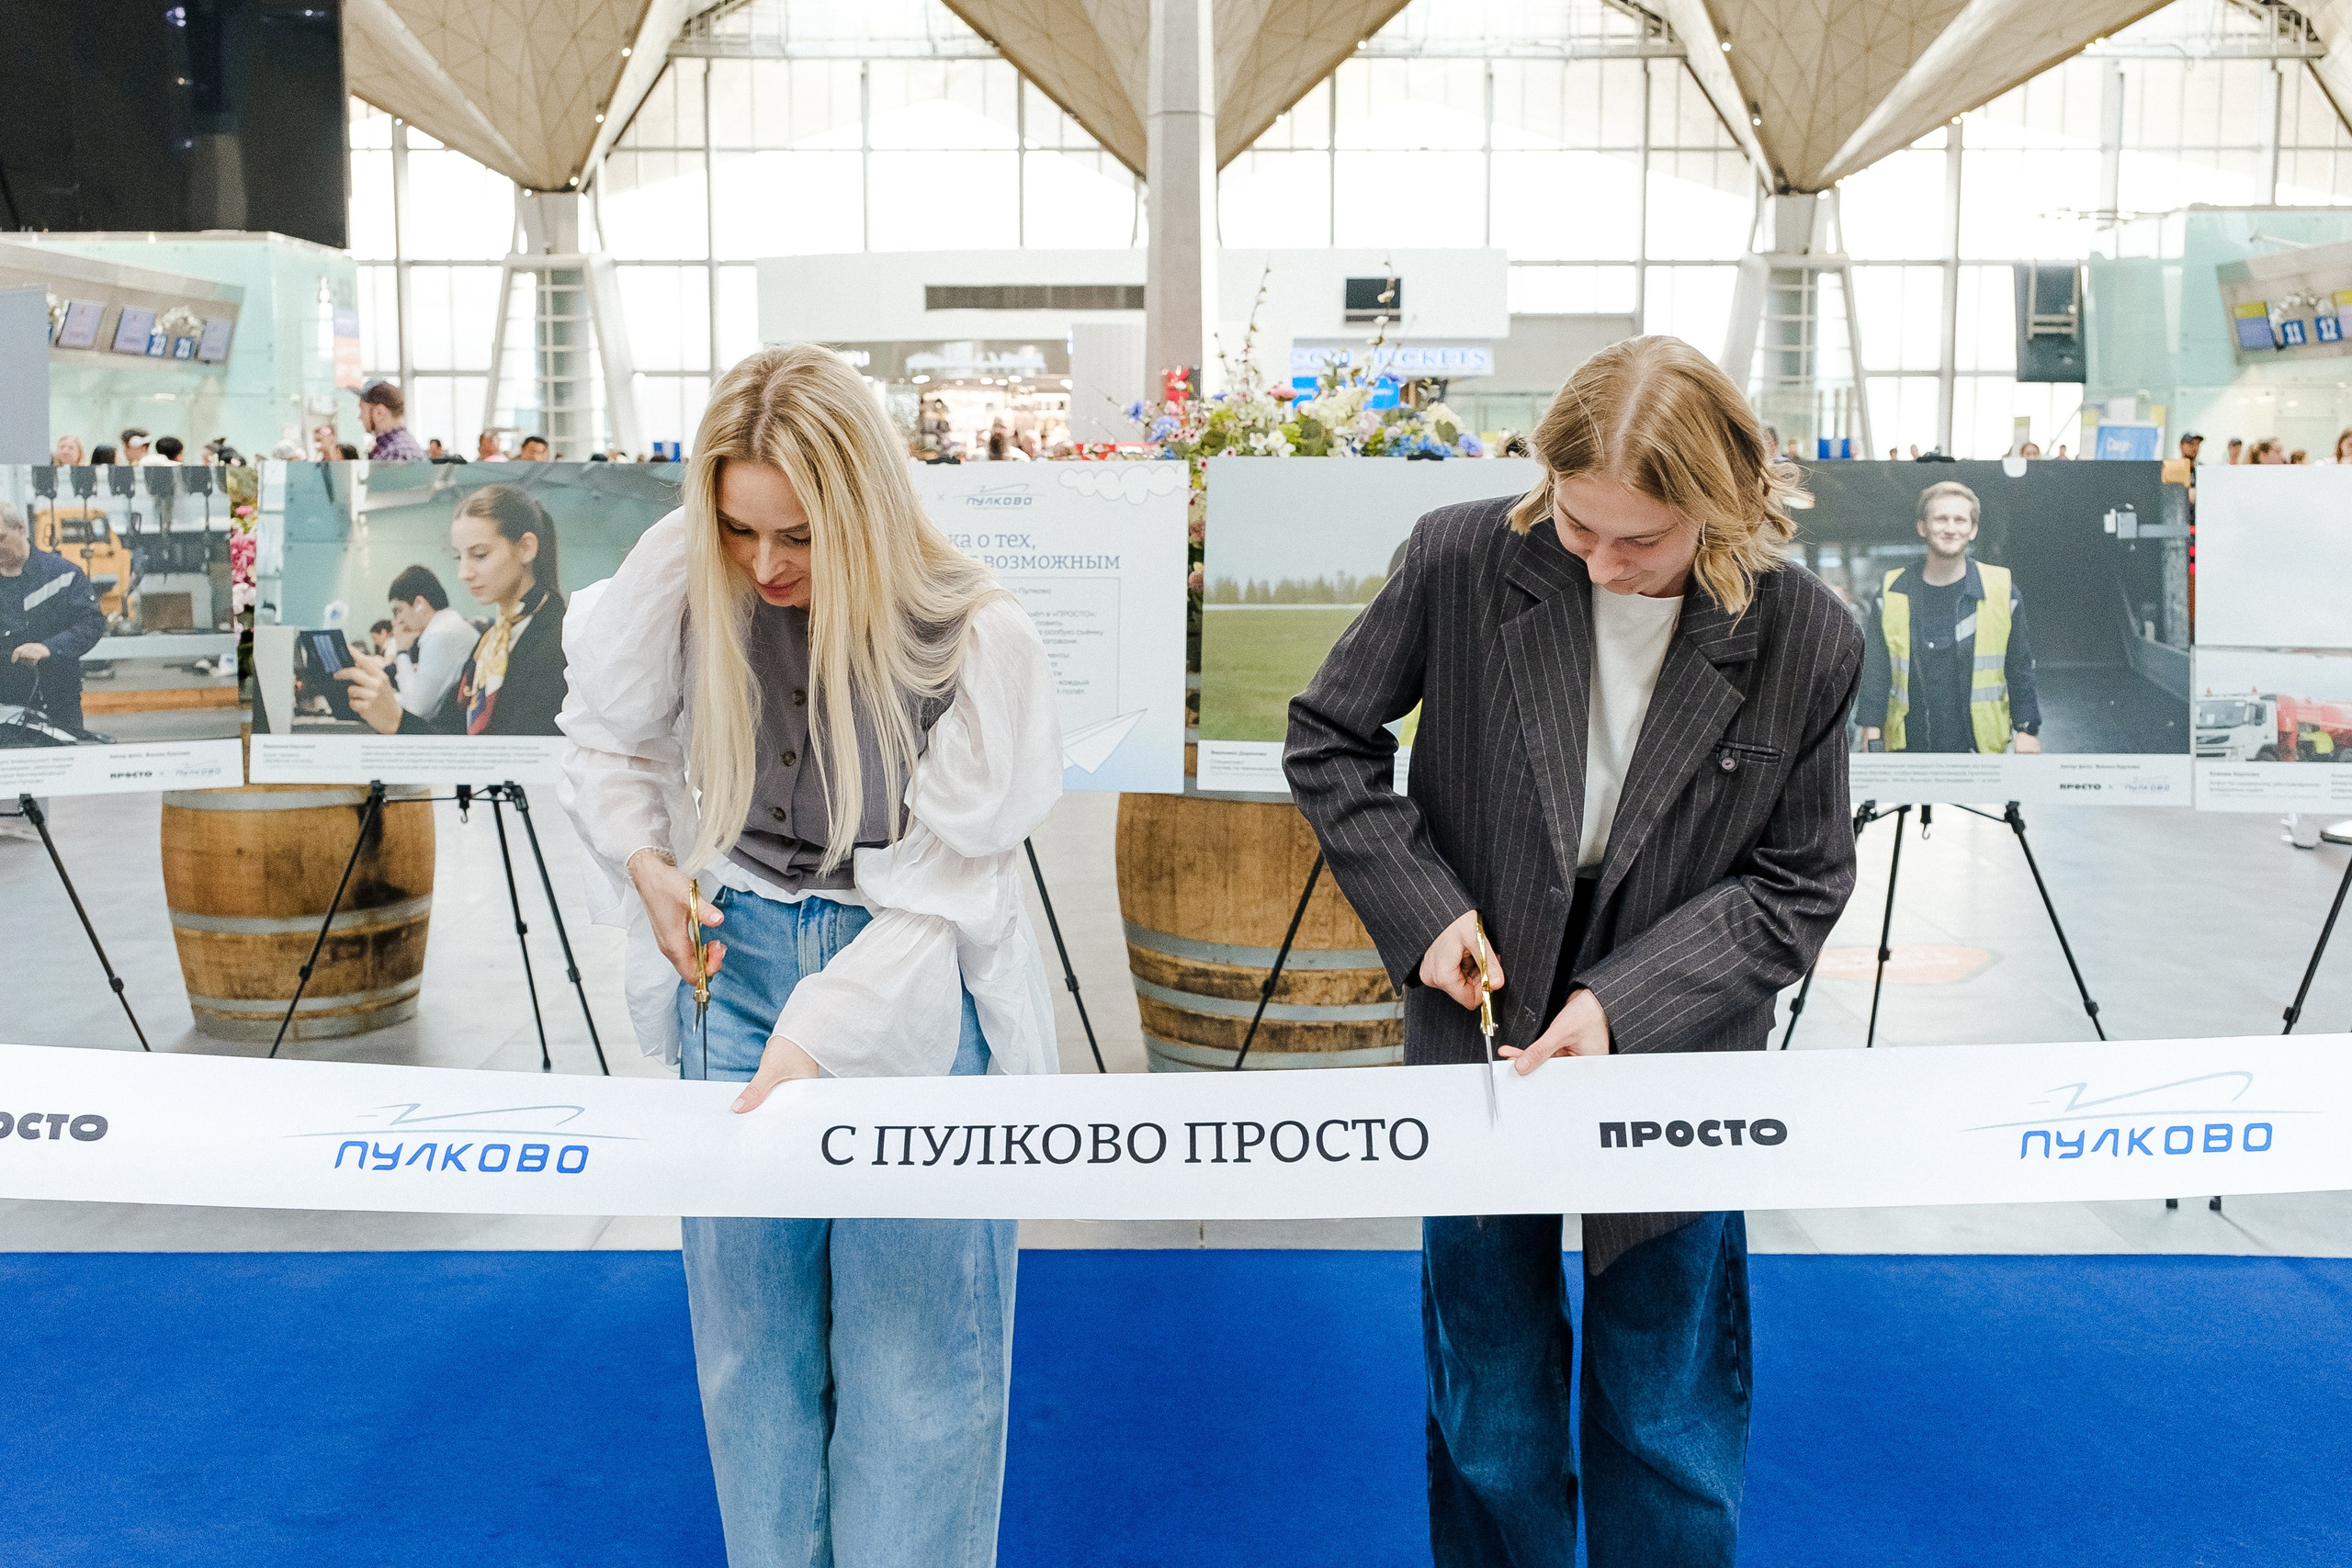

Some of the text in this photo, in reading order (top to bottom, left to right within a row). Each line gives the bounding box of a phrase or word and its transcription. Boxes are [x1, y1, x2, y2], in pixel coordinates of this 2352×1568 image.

[1372, 347, 1487, 368] TICKETS
[966, 497, 1033, 506] ПУЛКОВО
[978, 534, 990, 548] о
[995, 534, 1036, 550] тех,
[984, 555, 1120, 570] возможным
[820, 1117, 1429, 1167] С ПУЛКОВО ПРОСТО
[1599, 1118, 1788, 1148] ПРОСТО
[2020, 1122, 2273, 1159] ПУЛКОВО
[334, 1140, 589, 1174] ПУЛКОВО
